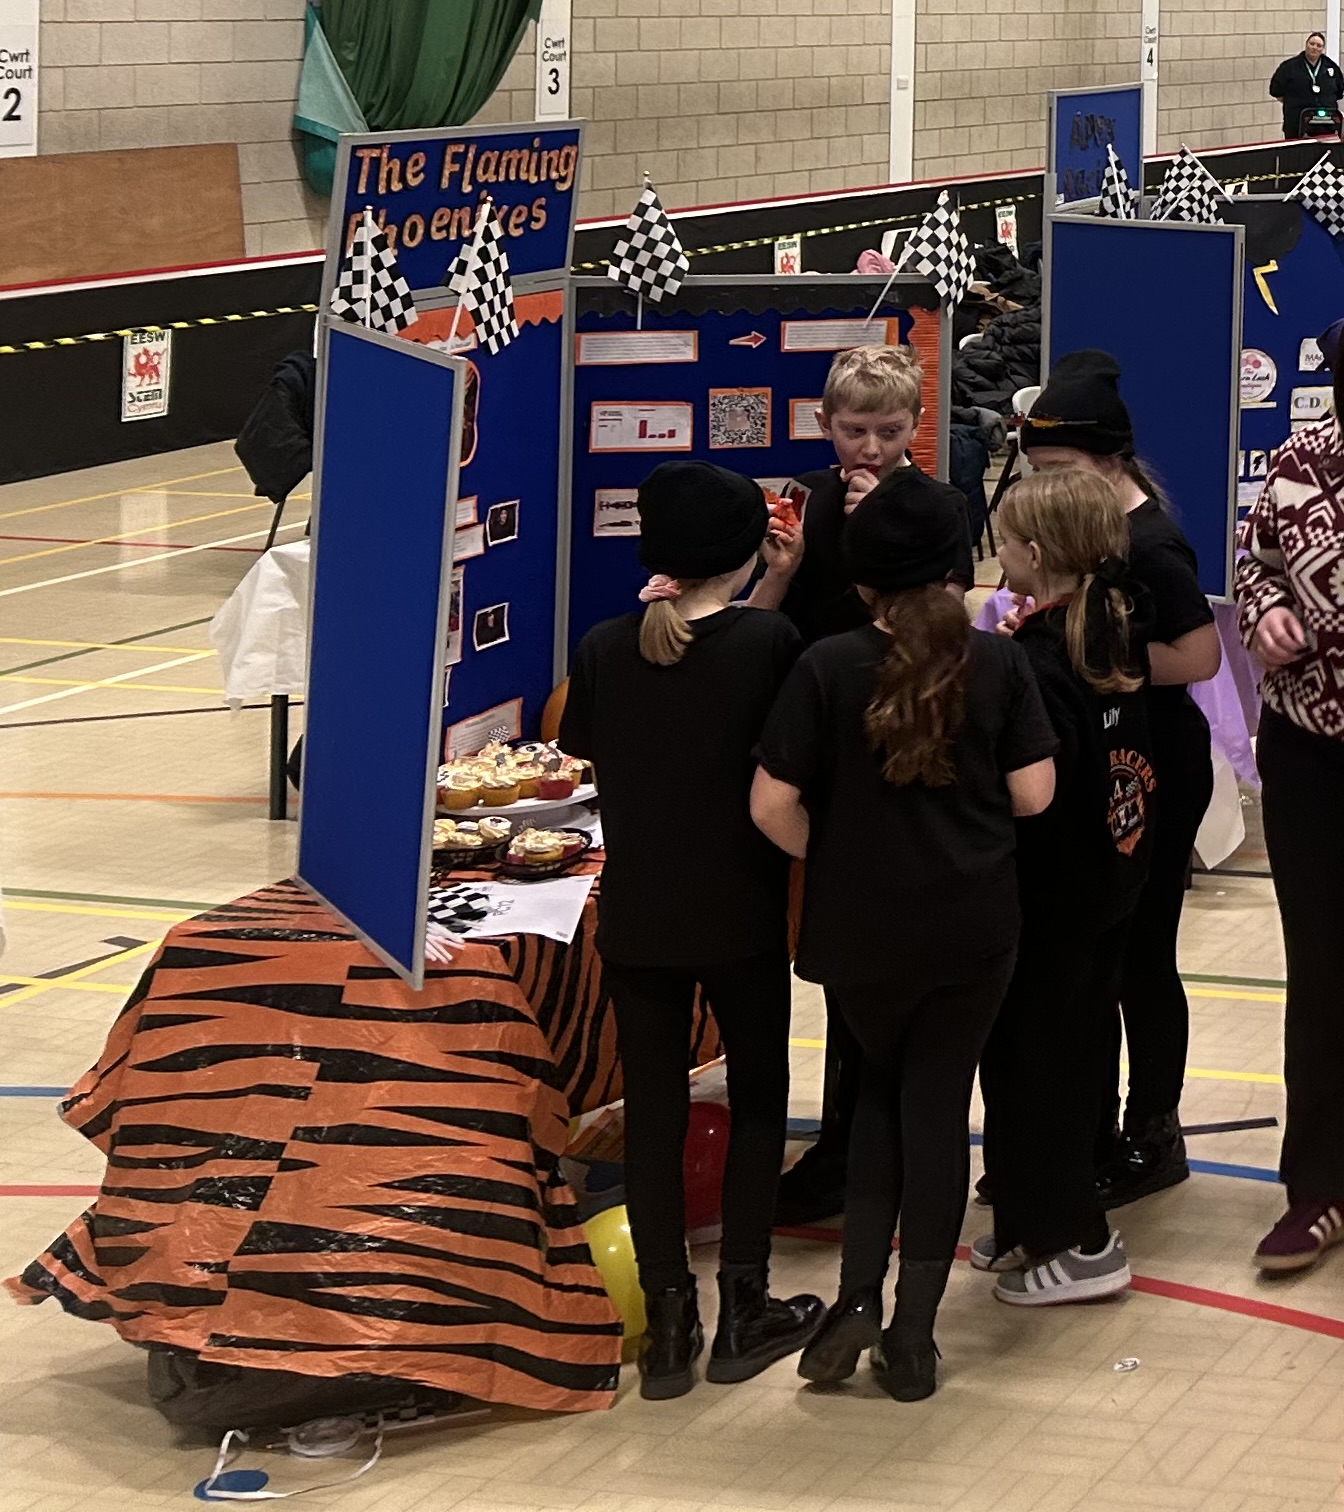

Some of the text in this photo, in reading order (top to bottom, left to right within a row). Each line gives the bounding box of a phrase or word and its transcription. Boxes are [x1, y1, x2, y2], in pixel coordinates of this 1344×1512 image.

[544, 37, 565, 49] Cwrt
[0, 48, 30, 63] Cwrt
[542, 50, 567, 62] Court
[1146, 47, 1153, 67] 4
[547, 67, 560, 95] 3
[2, 87, 22, 122] 2
[355, 137, 578, 195] The Flaming
[130, 331, 166, 345] EESW
[1103, 706, 1121, 729] Lily
[1108, 748, 1157, 793] RACERS
